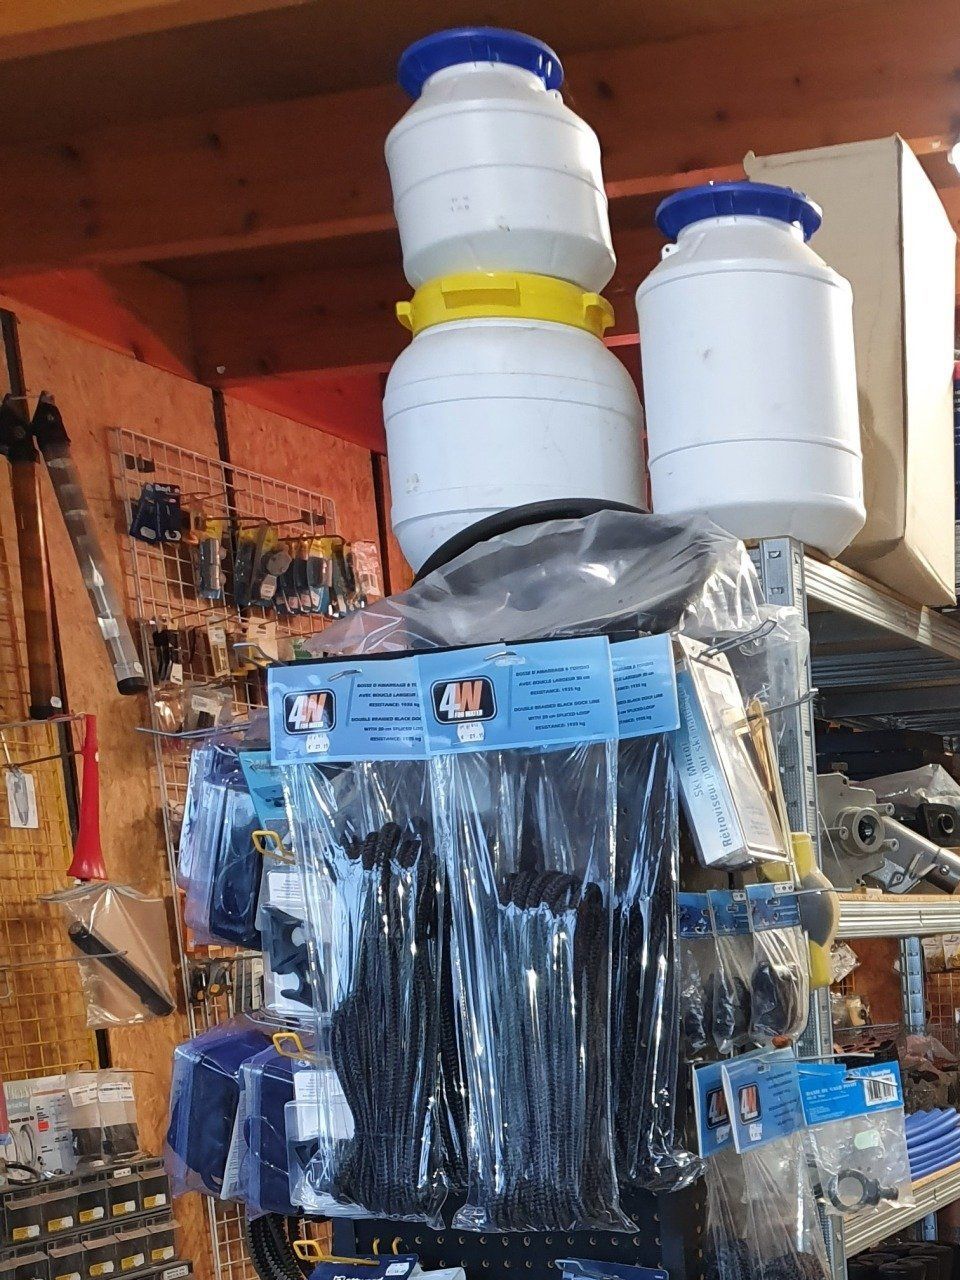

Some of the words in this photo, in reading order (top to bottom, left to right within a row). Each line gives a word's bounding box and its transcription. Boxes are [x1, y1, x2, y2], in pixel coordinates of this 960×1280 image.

[440, 681, 483, 719] 4W
[699, 756, 715, 779] pour
[693, 780, 703, 797] Ski
[707, 783, 733, 847] Rétroviseur
